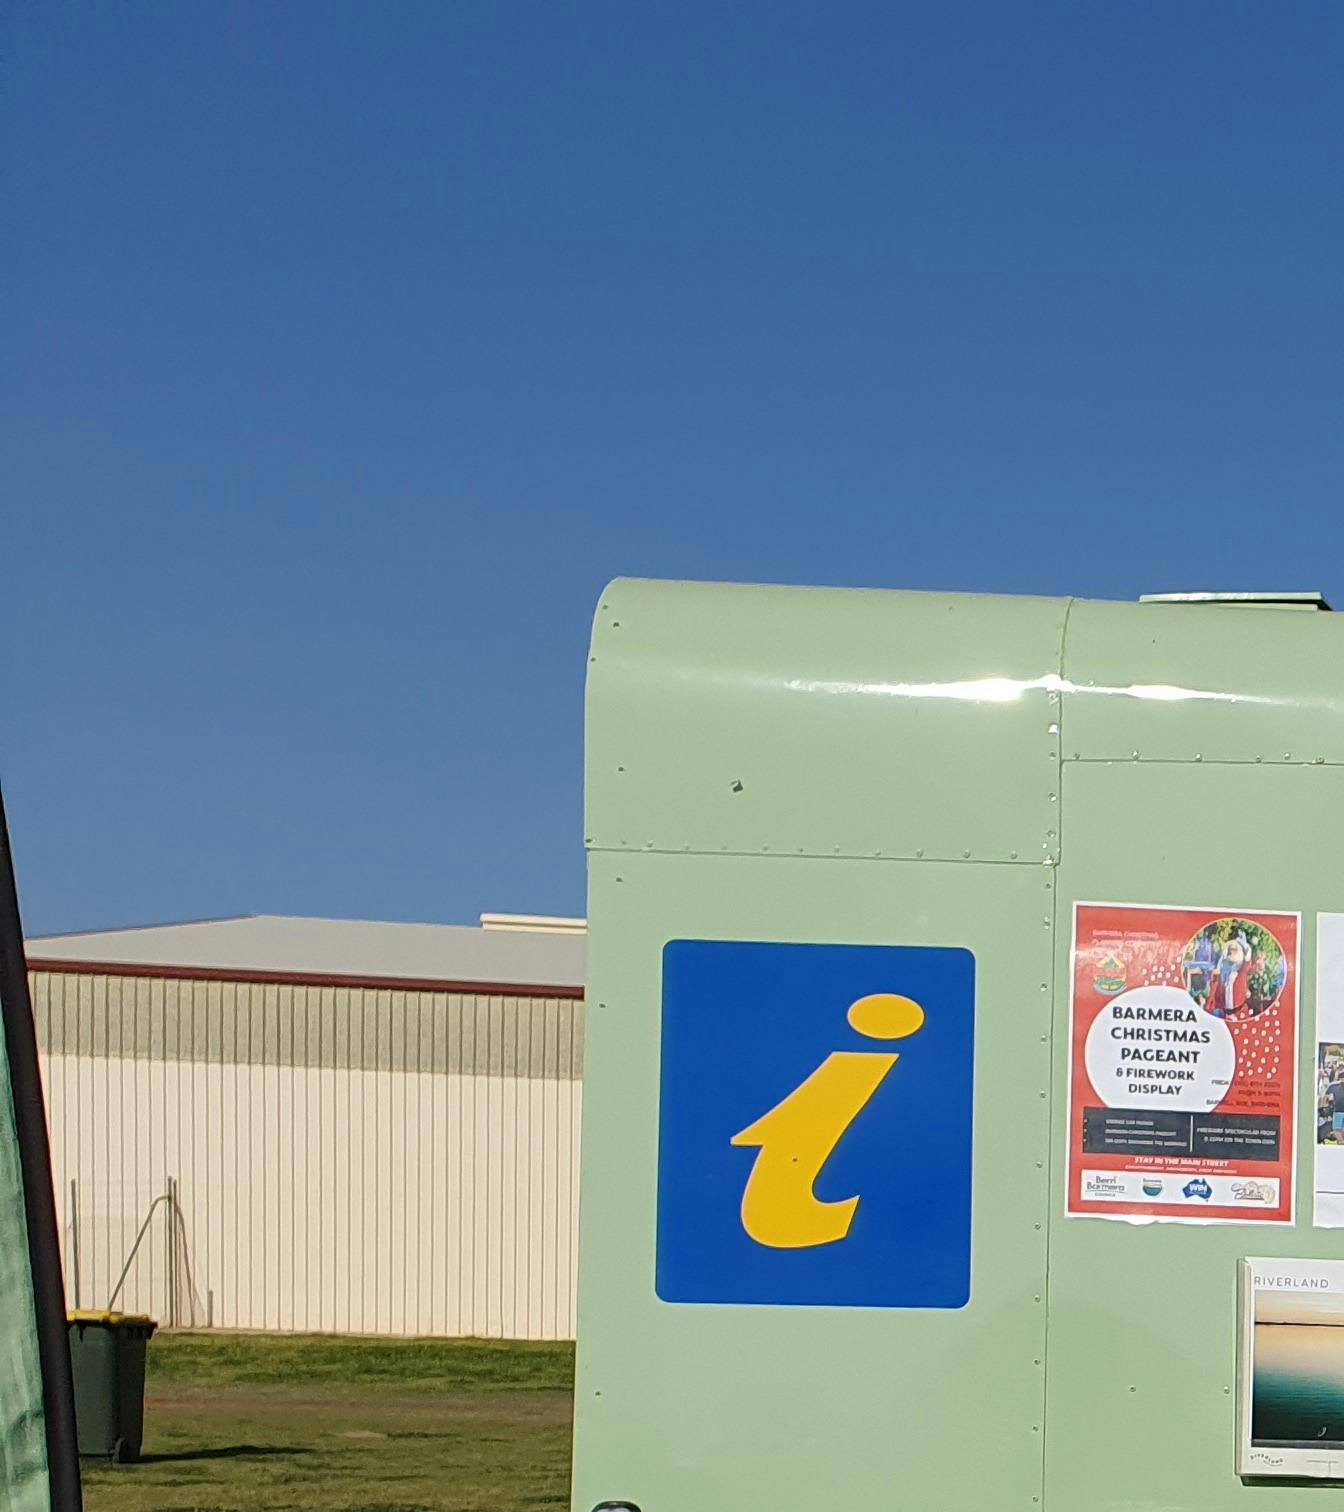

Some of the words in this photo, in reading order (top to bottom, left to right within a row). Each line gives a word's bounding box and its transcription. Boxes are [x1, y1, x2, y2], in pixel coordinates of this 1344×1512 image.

[1112, 1006, 1197, 1023] BARMERA
[1111, 1027, 1211, 1044] CHRISTMAS
[1121, 1048, 1201, 1064] PAGEANT
[1126, 1068, 1195, 1081] FIREWORK
[1128, 1083, 1183, 1096] DISPLAY
[1254, 1276, 1329, 1288] RIVERLAND
